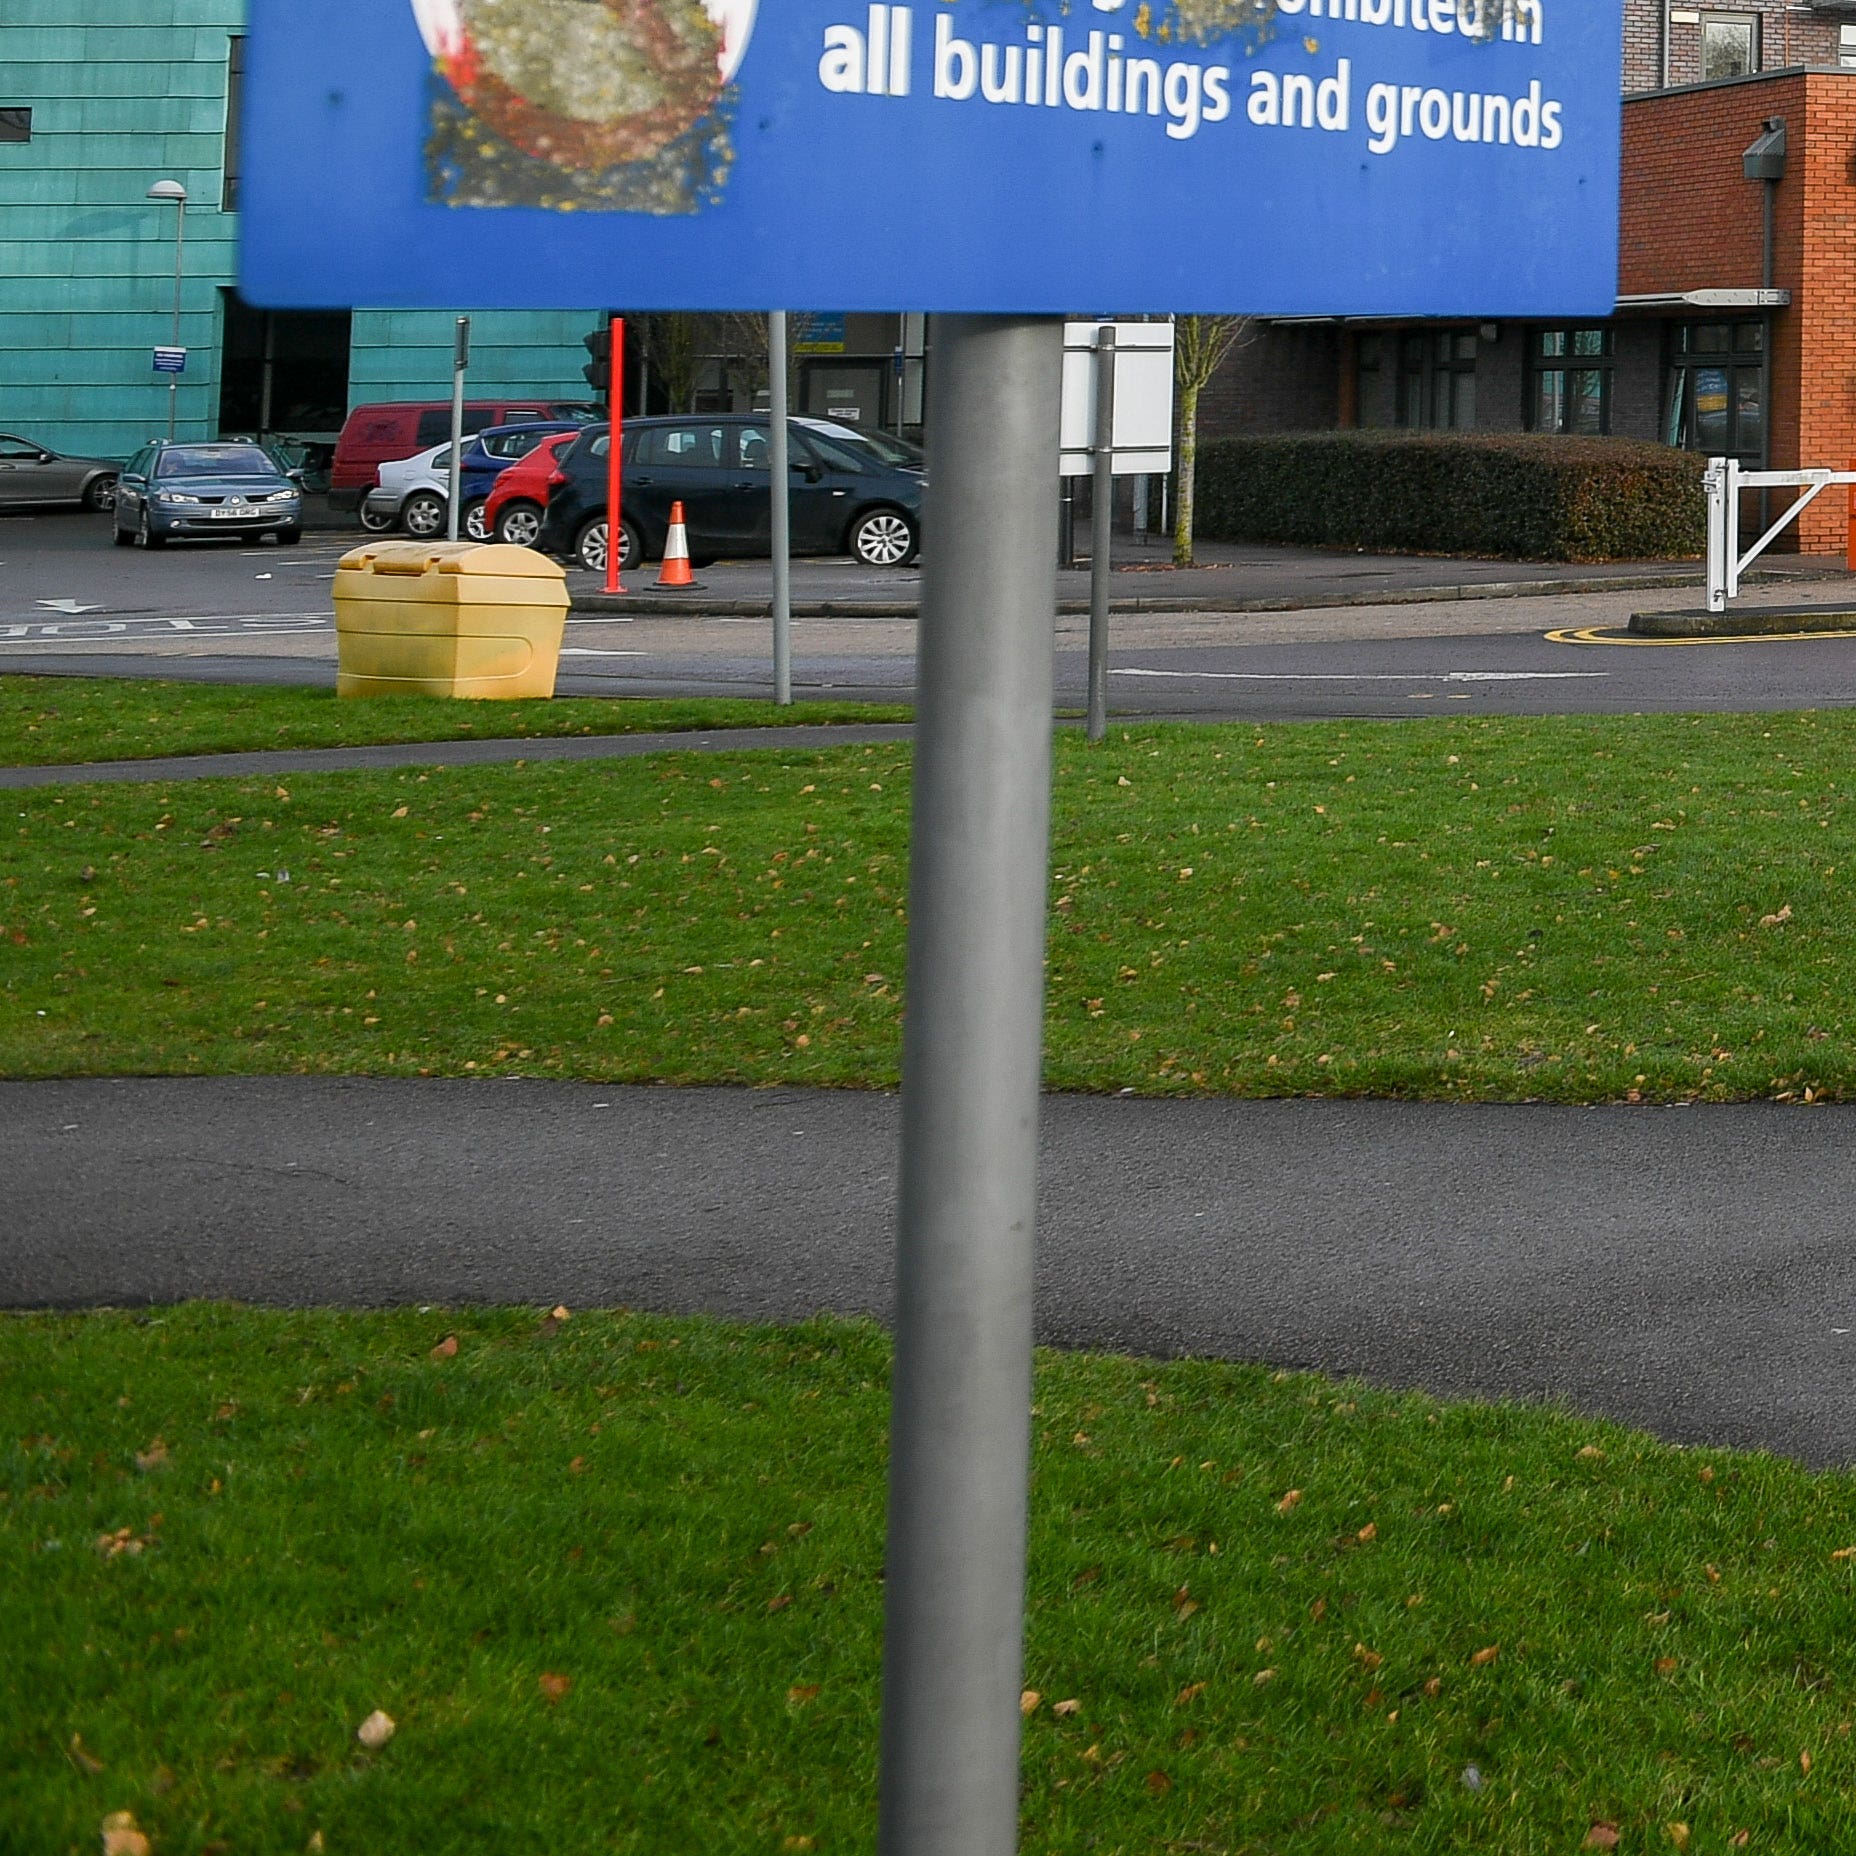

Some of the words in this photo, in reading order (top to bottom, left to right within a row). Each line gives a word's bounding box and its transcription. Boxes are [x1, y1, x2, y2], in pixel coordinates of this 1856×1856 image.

[817, 3, 912, 98] all
[933, 13, 1231, 141] buildings
[1247, 58, 1351, 132] and
[1366, 80, 1563, 156] grounds
